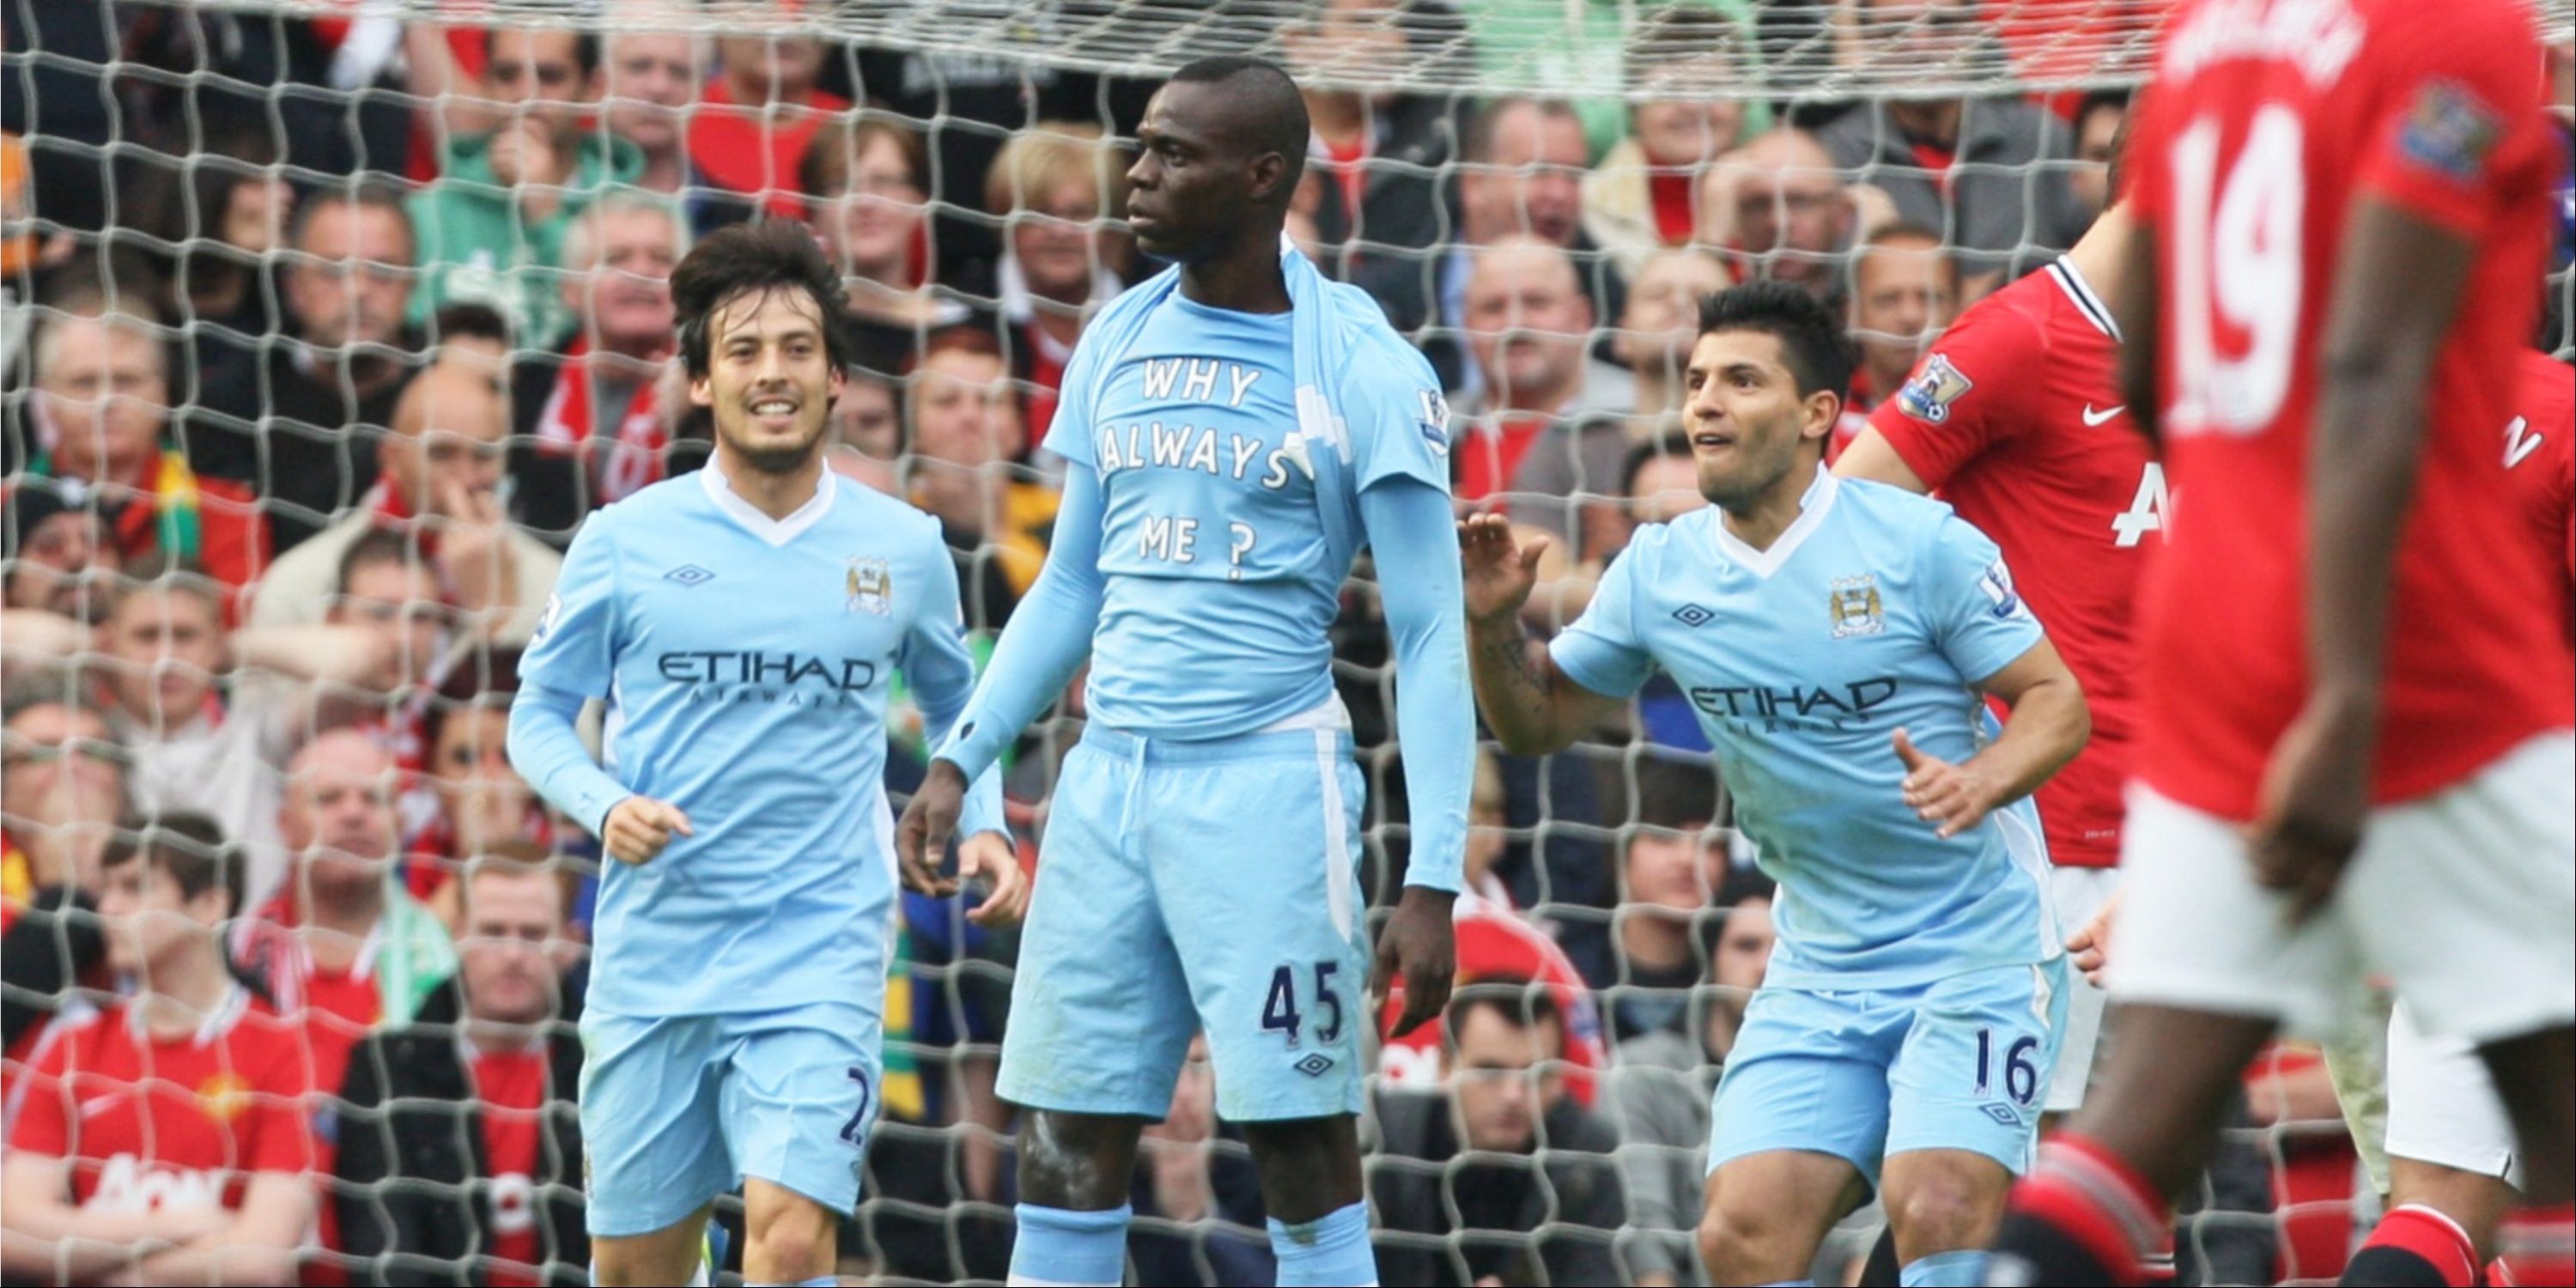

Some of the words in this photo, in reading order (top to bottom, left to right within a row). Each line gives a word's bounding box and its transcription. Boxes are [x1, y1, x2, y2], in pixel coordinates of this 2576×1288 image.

[2171, 100, 2306, 434] 19
[1142, 356, 1261, 407] WHY
[1102, 422, 1289, 490] ALWAYS
[1139, 515, 1199, 564] ME
[1227, 521, 1257, 581] ?
[658, 650, 876, 690] ETIHAD
[1691, 676, 1897, 717] ETIHAD
[1260, 960, 1342, 1051] 45
[1974, 1028, 2038, 1107] 16
